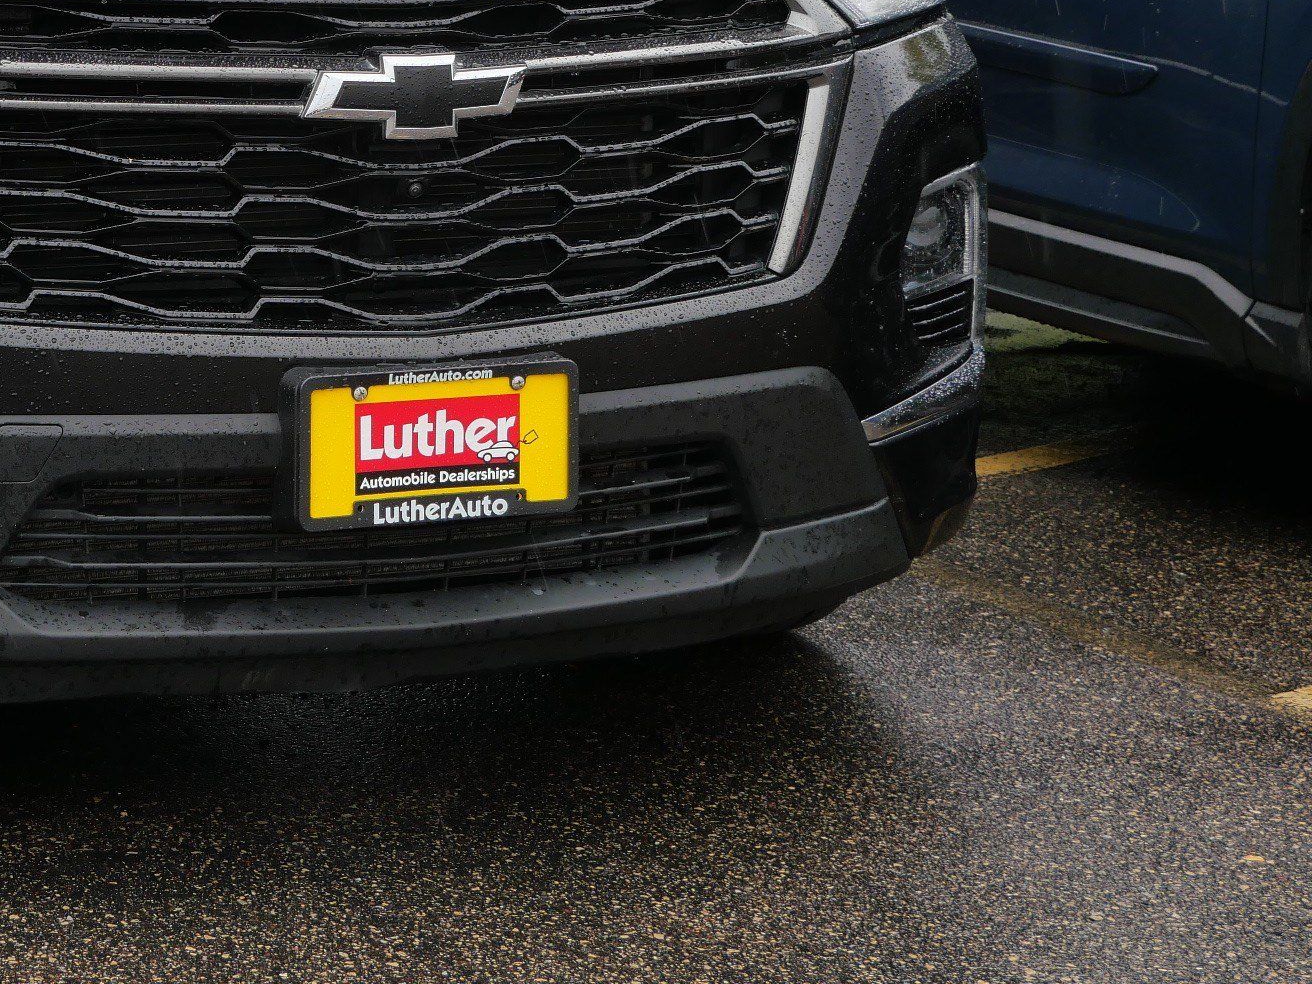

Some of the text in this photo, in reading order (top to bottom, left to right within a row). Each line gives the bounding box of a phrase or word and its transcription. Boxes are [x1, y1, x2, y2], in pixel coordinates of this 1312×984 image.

[388, 368, 493, 385] LutherAuto.com
[360, 409, 517, 460] Luther
[359, 467, 515, 490] Automobile Dealerships
[373, 496, 508, 524] LutherAuto
